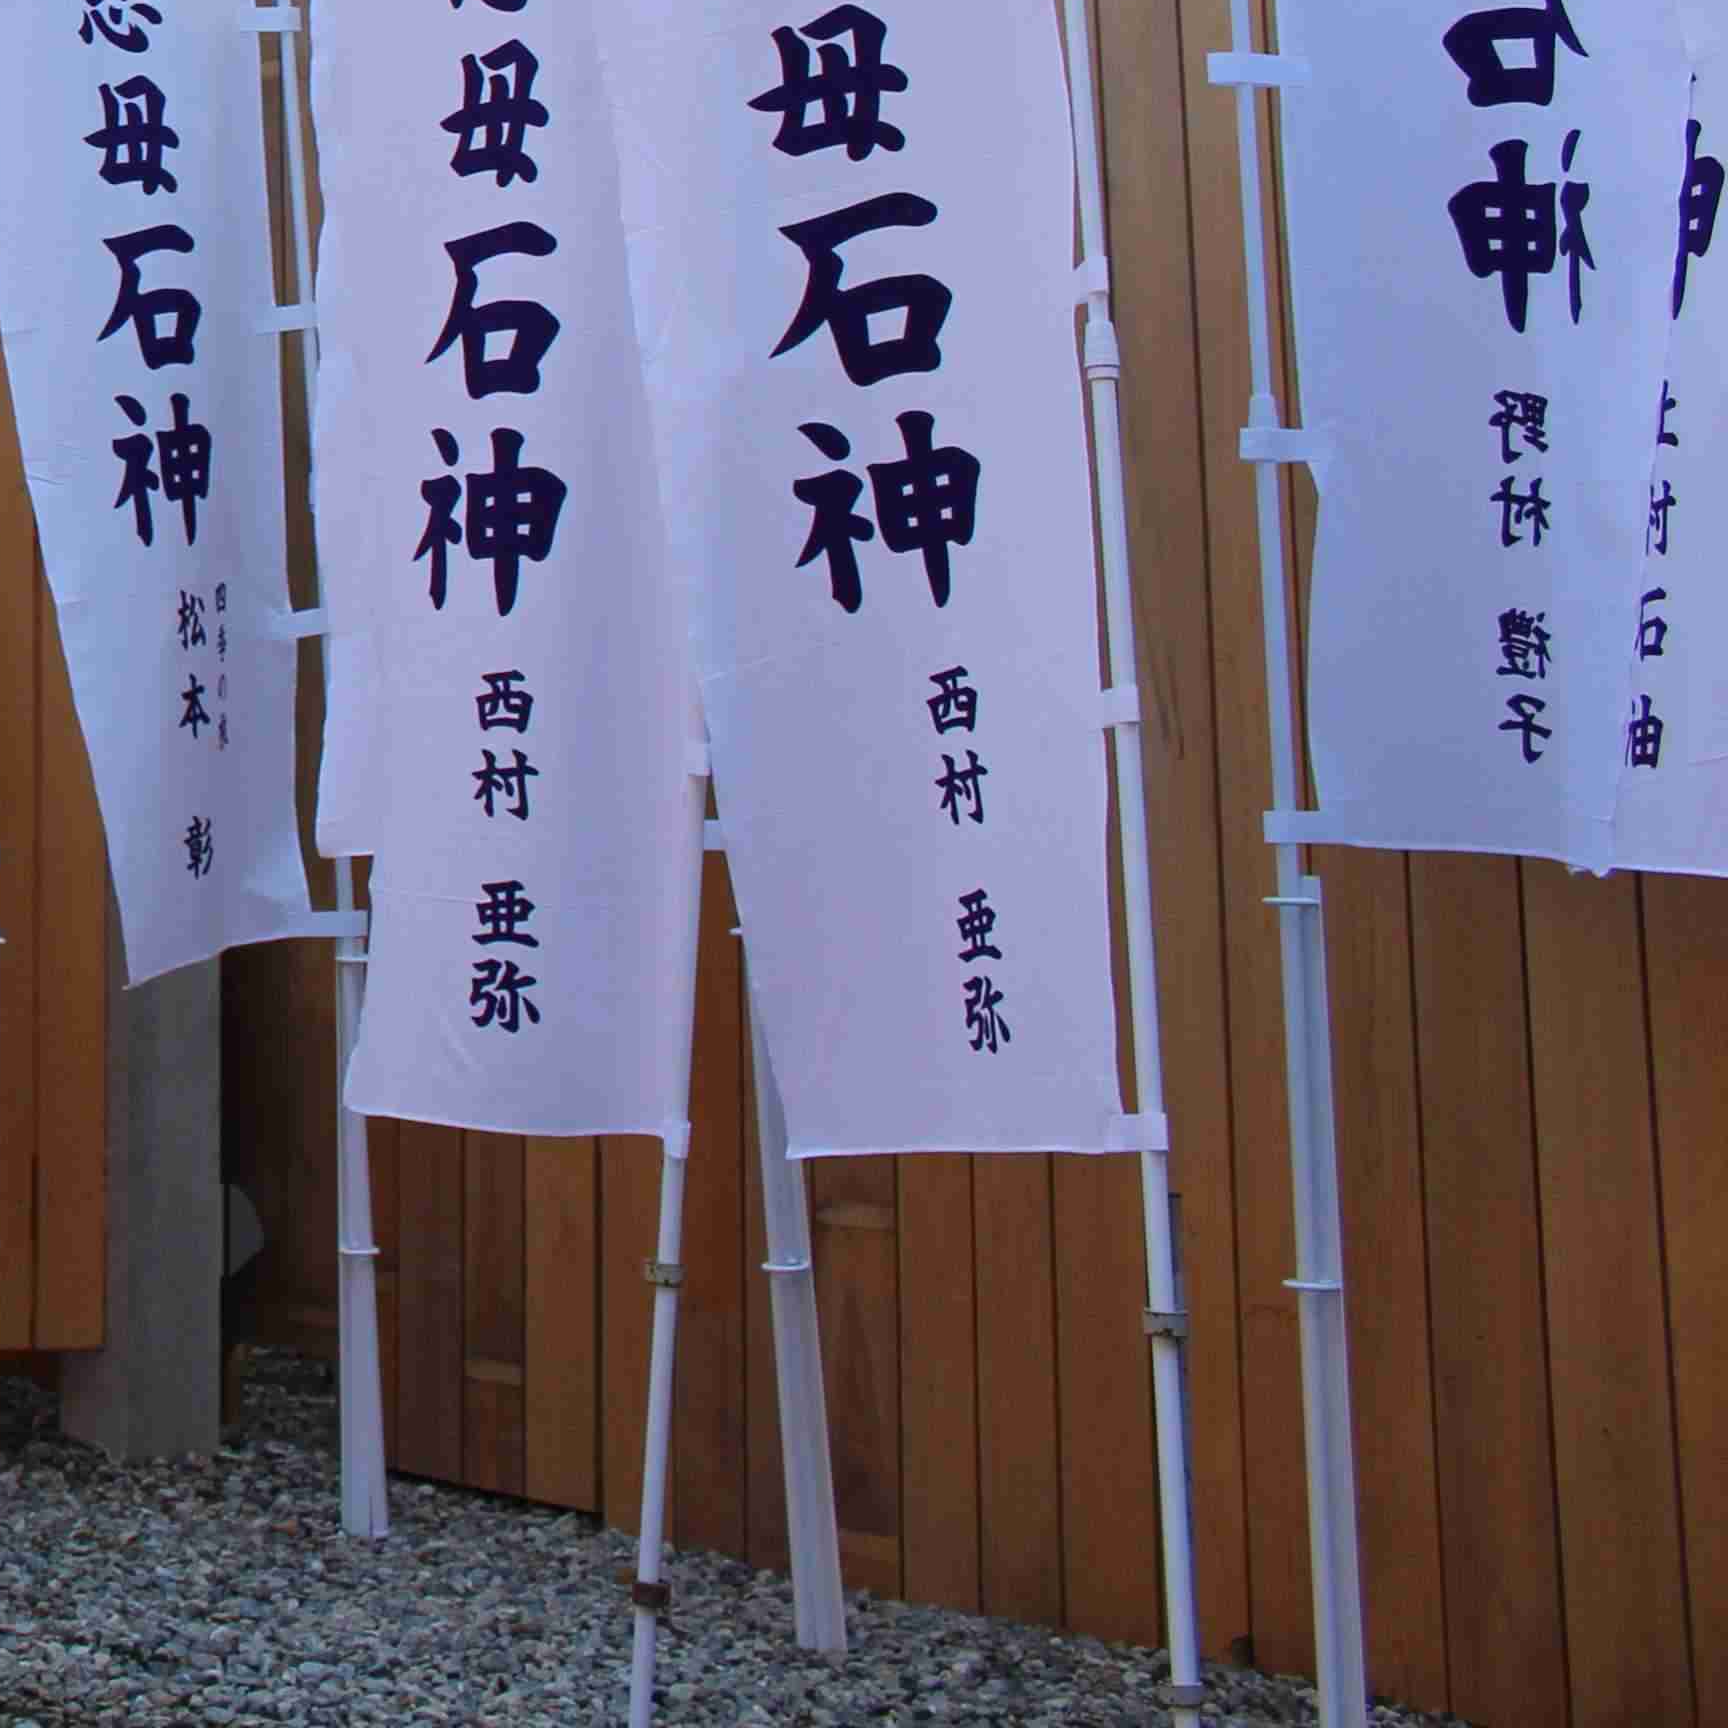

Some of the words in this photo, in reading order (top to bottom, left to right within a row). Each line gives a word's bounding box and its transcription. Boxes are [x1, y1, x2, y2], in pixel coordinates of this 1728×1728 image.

[177, 590, 211, 739] 松本
[471, 669, 539, 821] 西村
[926, 665, 988, 825] 西村
[183, 815, 214, 879] 彰
[469, 880, 541, 1034] 亜弥
[956, 888, 1011, 1054] 亜弥
